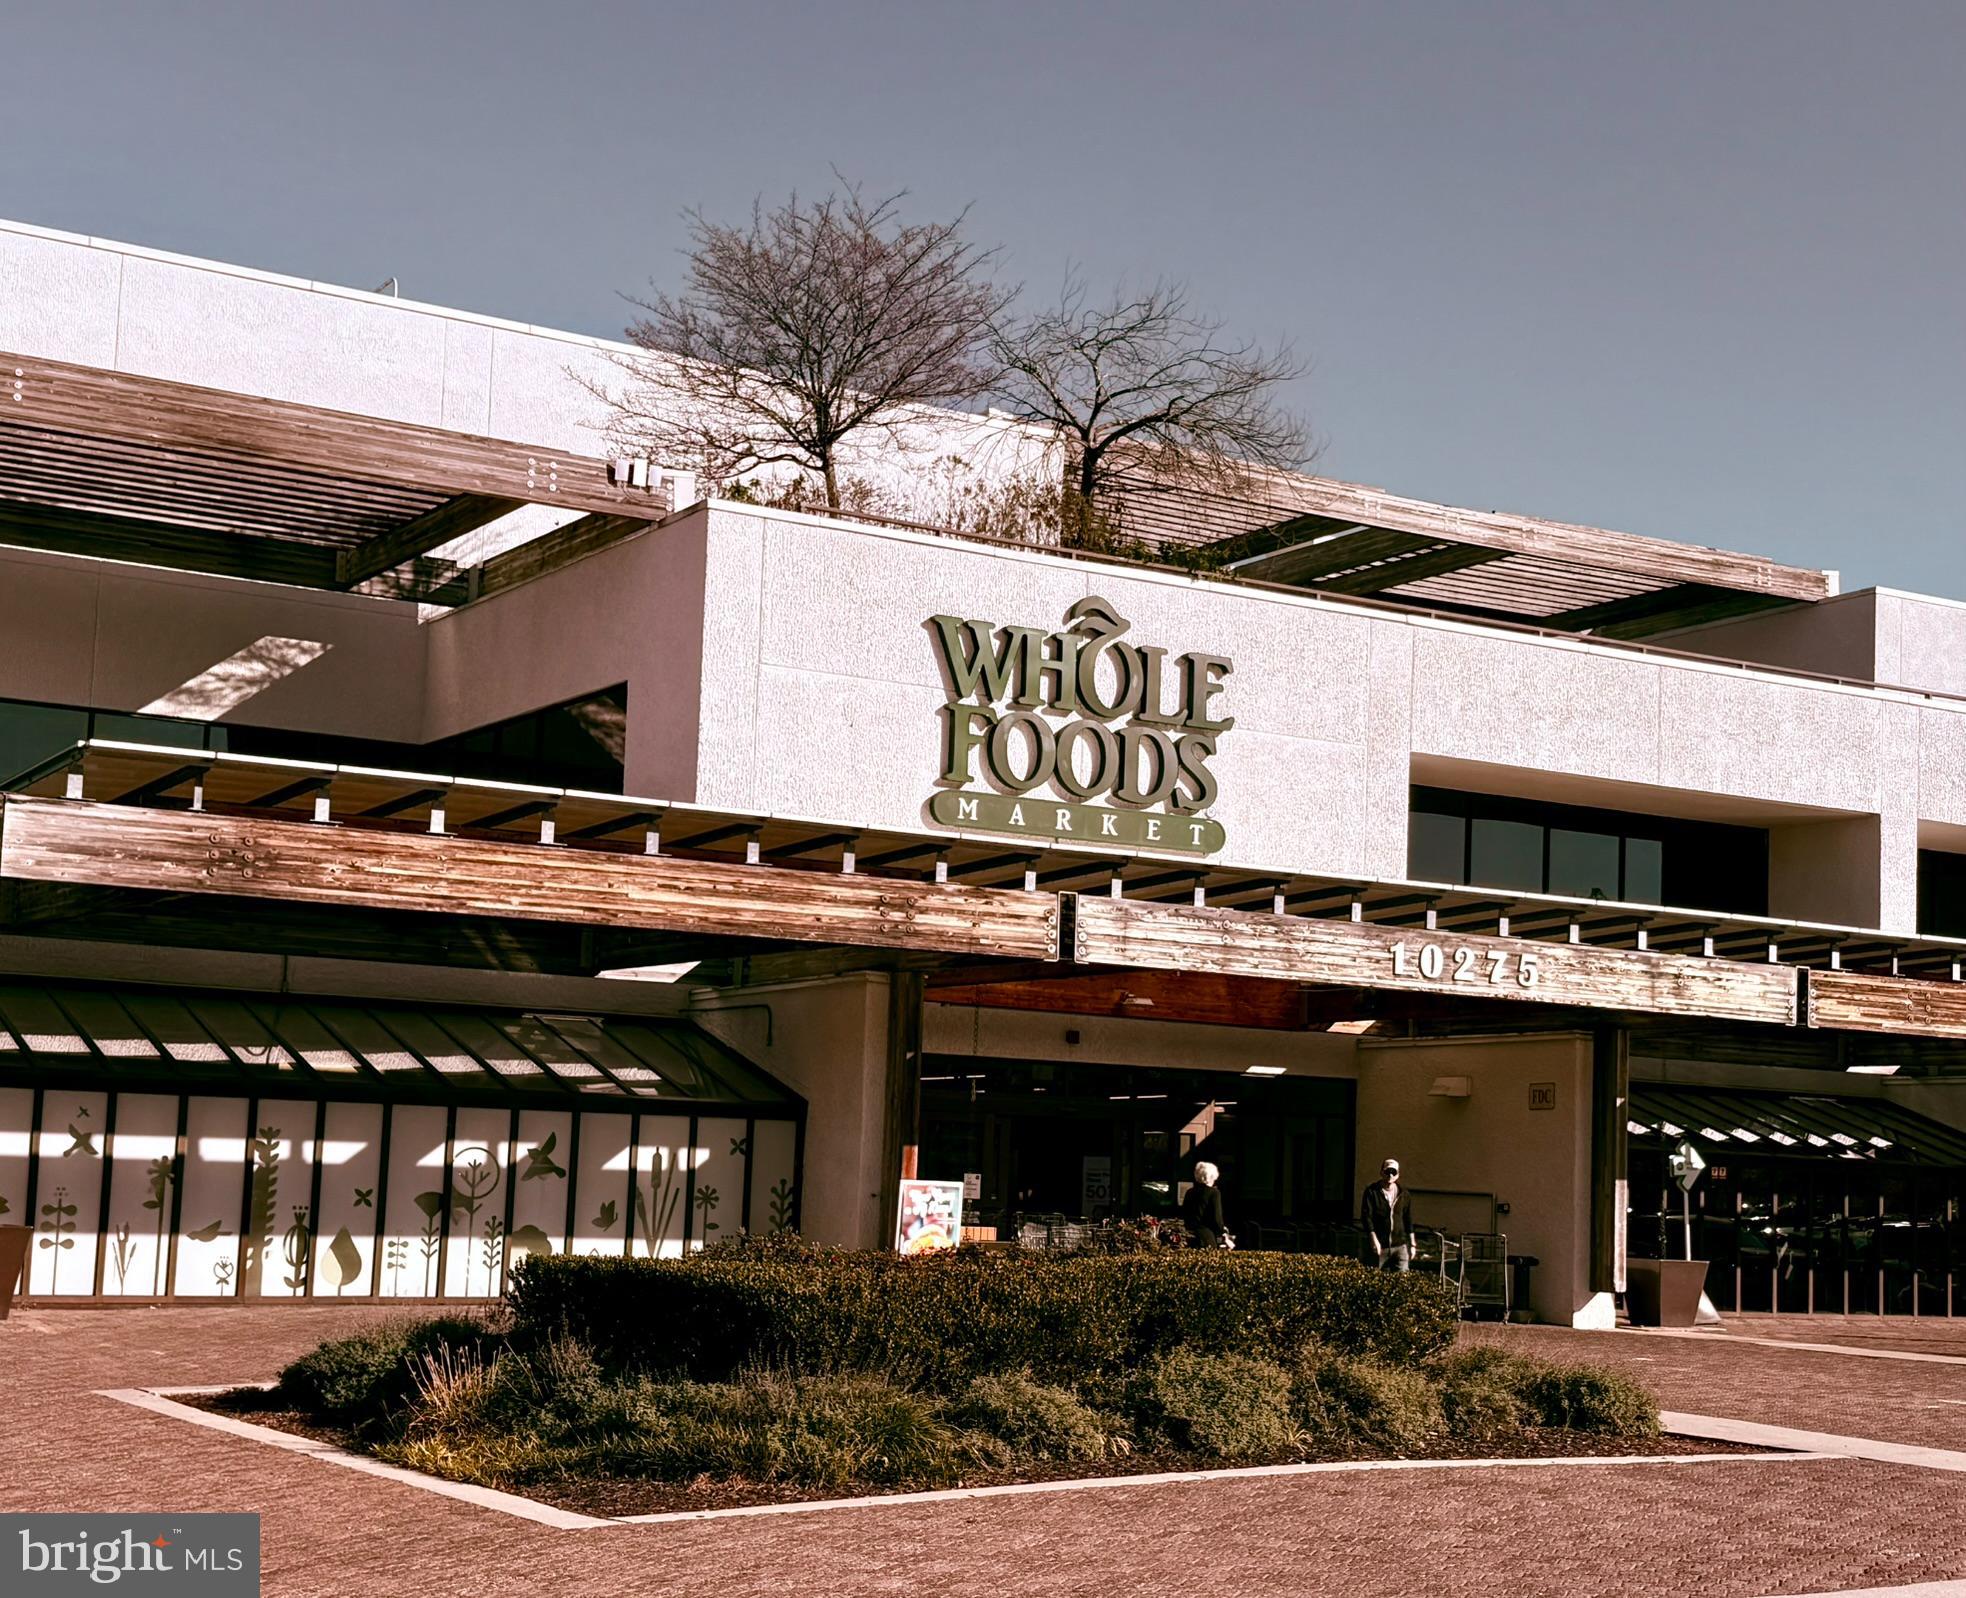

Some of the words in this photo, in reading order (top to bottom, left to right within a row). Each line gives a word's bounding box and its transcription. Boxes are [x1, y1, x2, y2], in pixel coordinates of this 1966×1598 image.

[922, 596, 1235, 734] WHOLE
[933, 703, 1218, 815] FOODS
[957, 797, 1206, 846] MARKET
[1390, 941, 1540, 988] 10275
[1532, 1088, 1552, 1105] FDC
